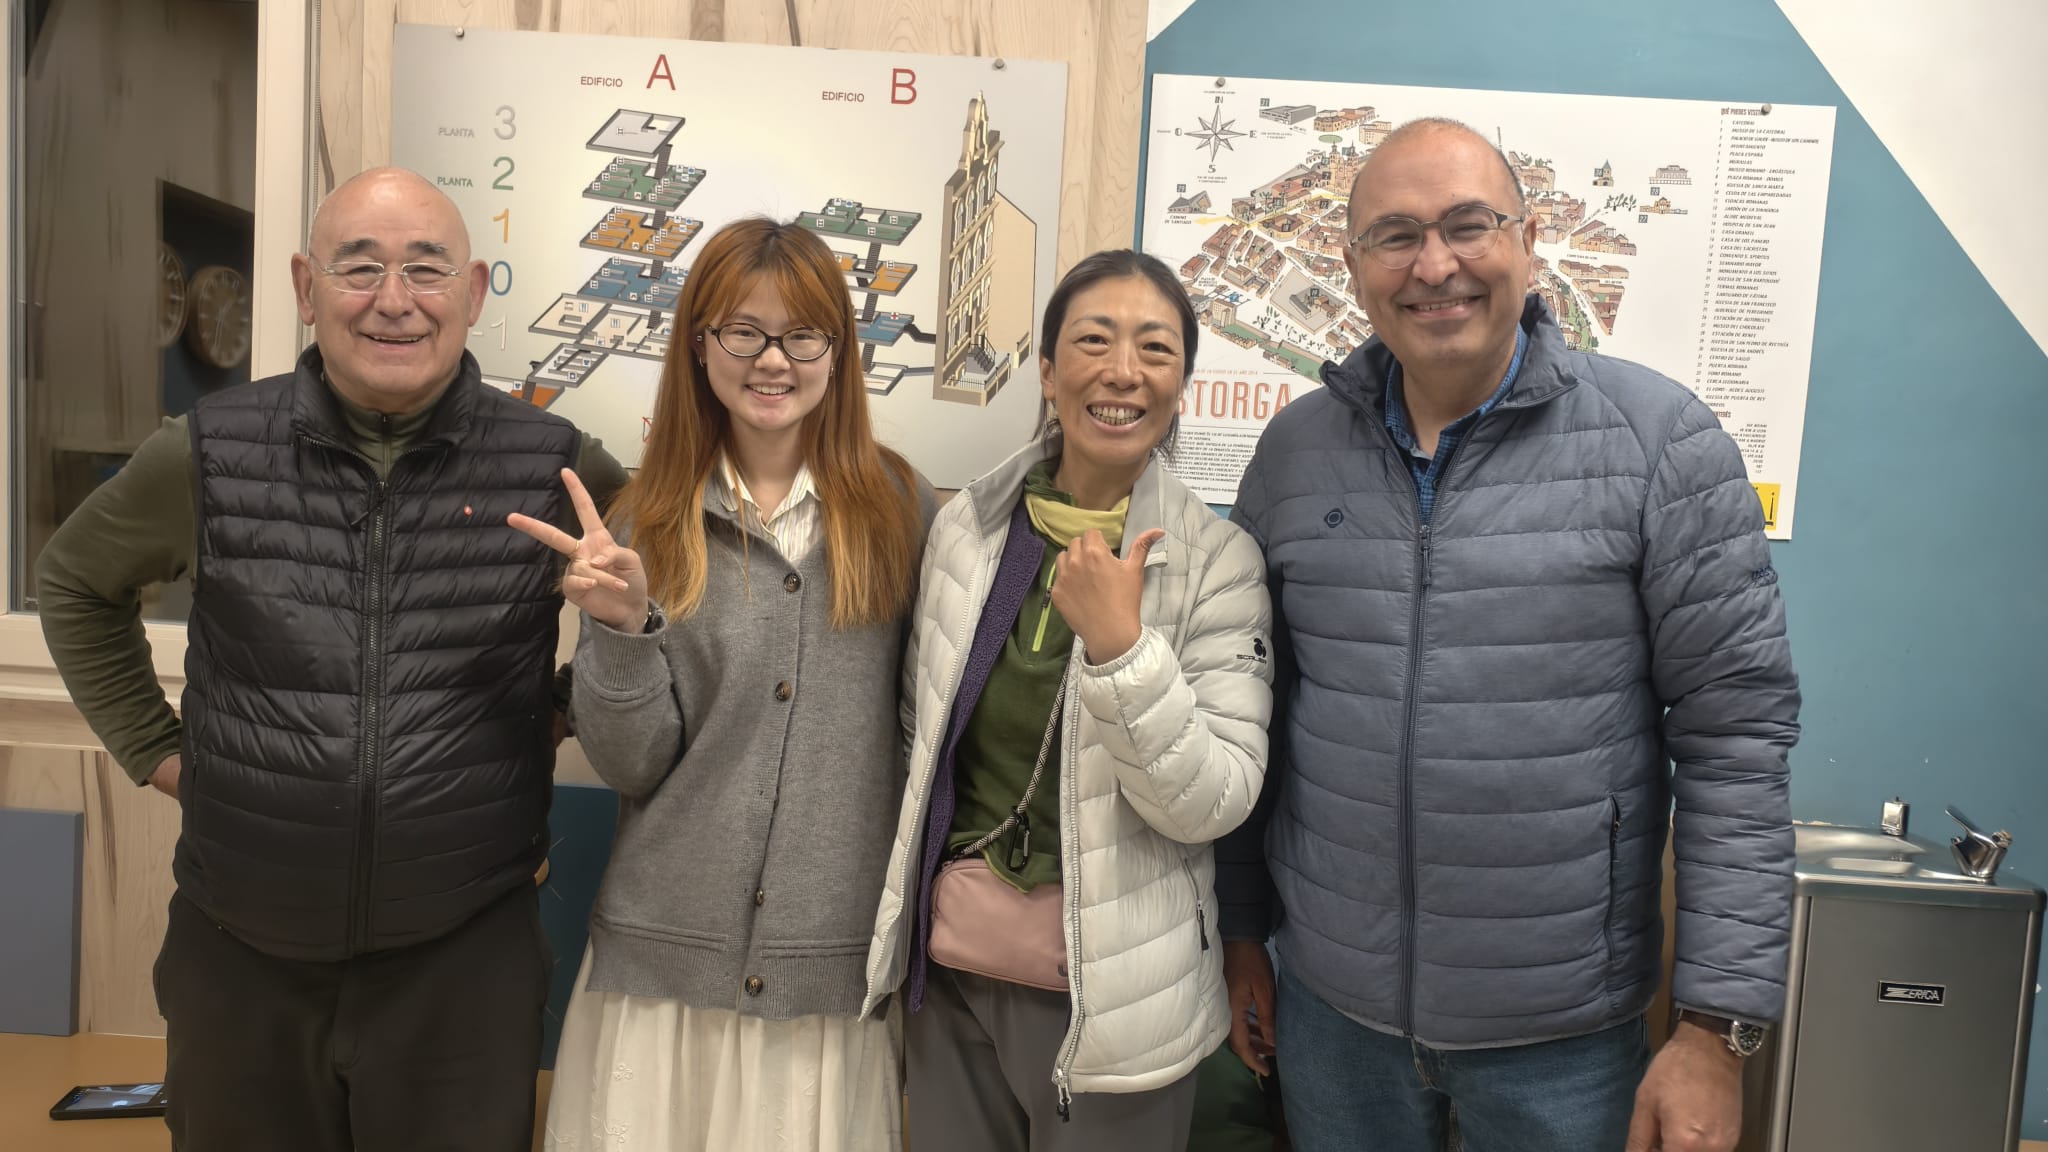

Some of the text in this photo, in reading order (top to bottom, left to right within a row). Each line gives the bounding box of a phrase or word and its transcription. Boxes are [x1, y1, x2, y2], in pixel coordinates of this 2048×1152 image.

[580, 54, 676, 90] EDIFICIO A
[822, 68, 917, 104] EDIFICIO B
[439, 105, 516, 140] PLANTA 3
[437, 156, 515, 190] PLANTA 2
[493, 208, 509, 244] 1
[490, 261, 512, 296] 0
[472, 314, 507, 350] -1
[1884, 987, 1940, 1000] ZERICA
